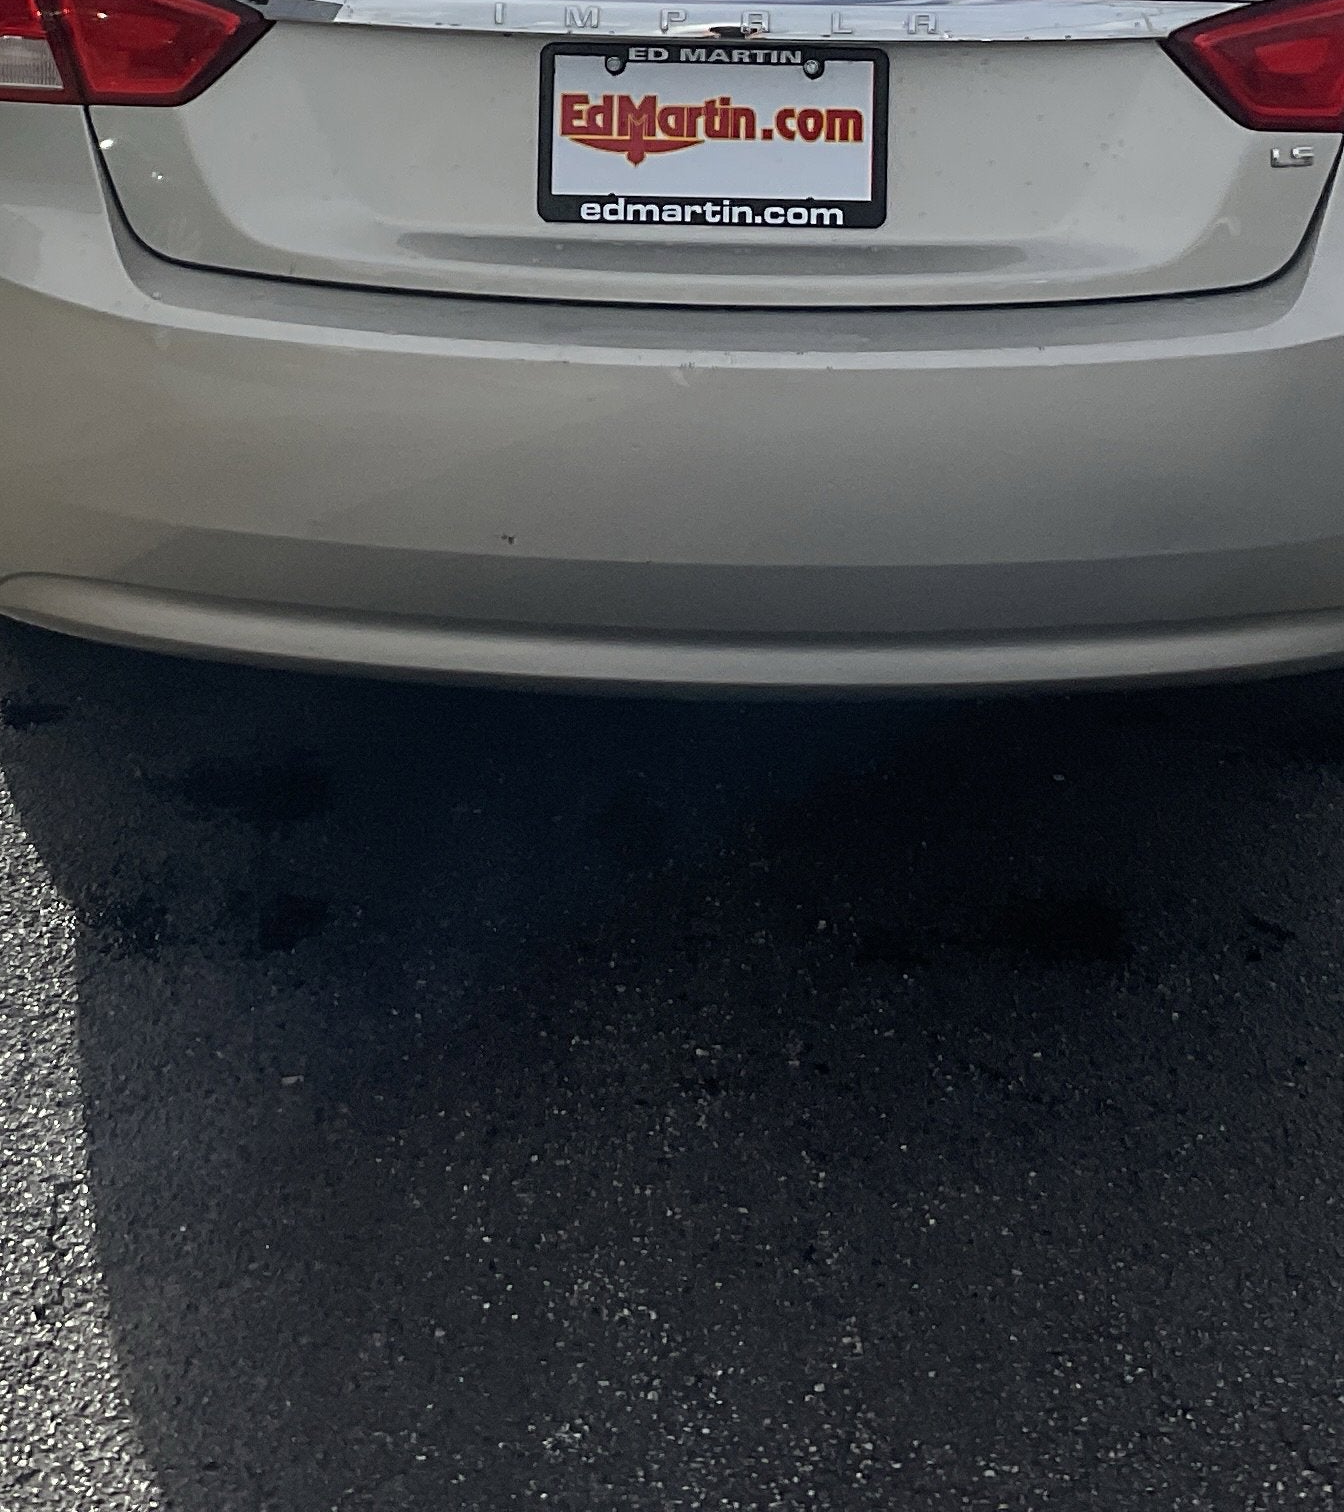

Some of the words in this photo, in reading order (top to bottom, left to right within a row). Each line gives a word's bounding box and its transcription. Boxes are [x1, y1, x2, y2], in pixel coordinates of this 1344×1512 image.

[494, 1, 937, 35] IMPALA
[628, 47, 670, 62] ED
[679, 49, 803, 65] MARTIN
[560, 93, 865, 144] EdMartin.com
[579, 197, 845, 226] edmartin.com
